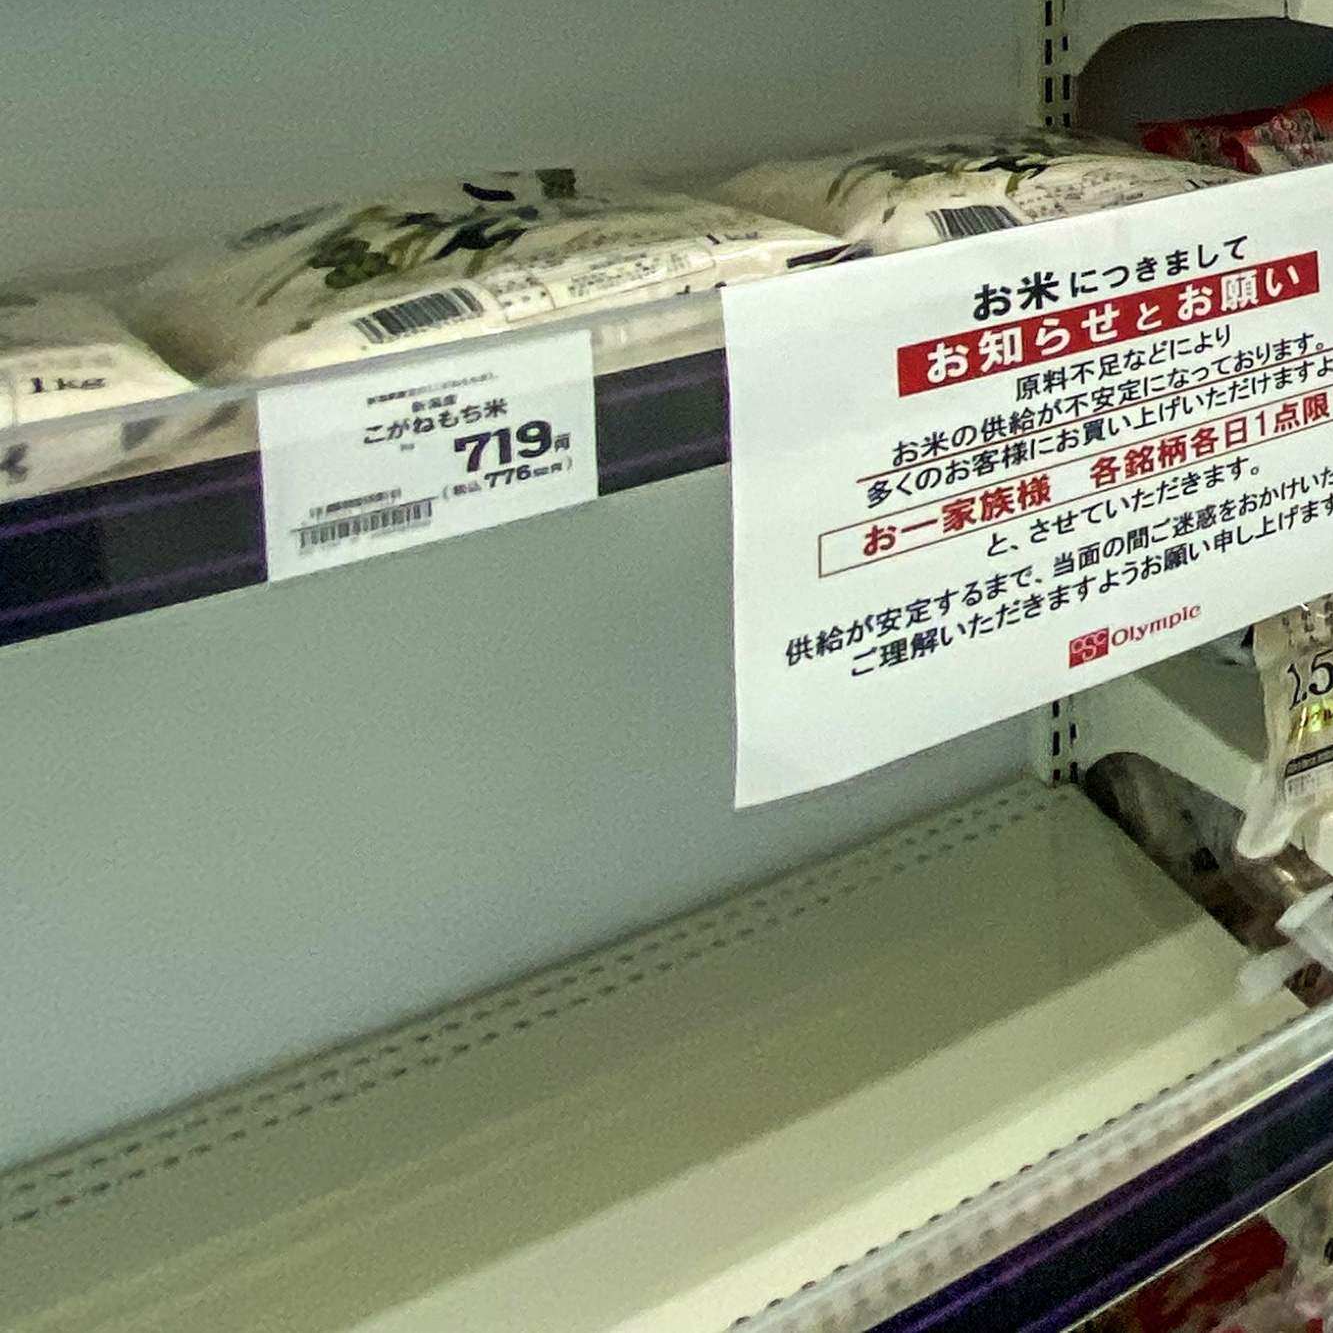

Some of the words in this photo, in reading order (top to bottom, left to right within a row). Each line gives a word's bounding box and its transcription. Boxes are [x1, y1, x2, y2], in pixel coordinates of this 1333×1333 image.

[973, 235, 1249, 321] お米につきまして
[926, 264, 1301, 384] お知らせとお願い
[1015, 324, 1232, 402] 原料不足などにより
[363, 398, 508, 444] こがねもち米
[893, 331, 1326, 465] お米の供給が不安定になっております。
[863, 473, 1052, 557] お一家族様
[986, 459, 1261, 557] と、させていただきます。
[1111, 604, 1202, 647] Olympic
